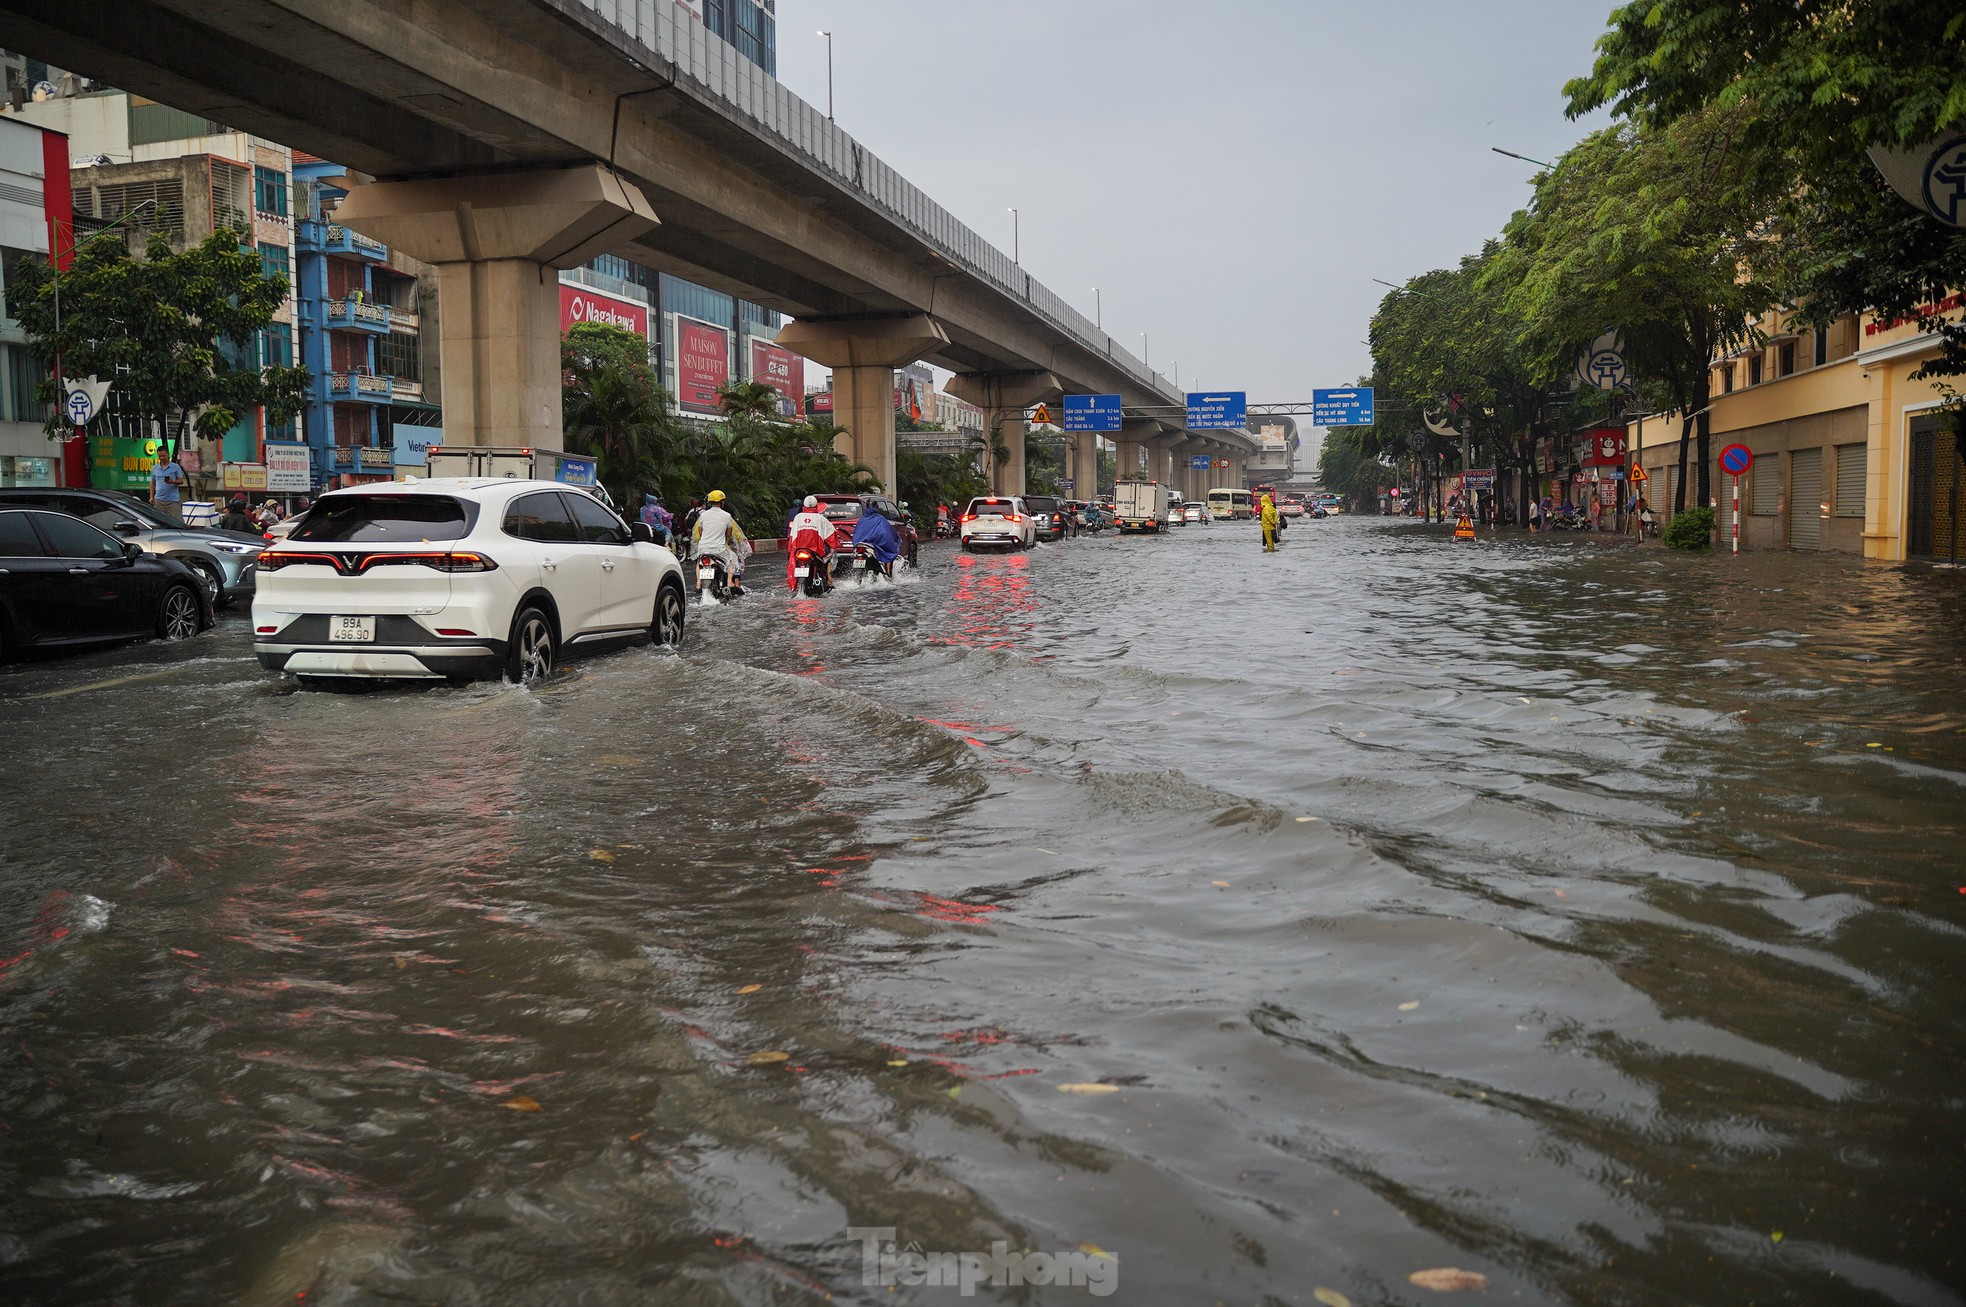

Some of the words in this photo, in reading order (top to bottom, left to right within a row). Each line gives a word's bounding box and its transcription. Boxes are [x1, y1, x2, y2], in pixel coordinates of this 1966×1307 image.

[586, 301, 635, 332] Nagakawa
[691, 336, 717, 356] MAISON
[123, 454, 138, 471] BÚN
[342, 618, 362, 628] 89A
[334, 630, 369, 640] 496.90
